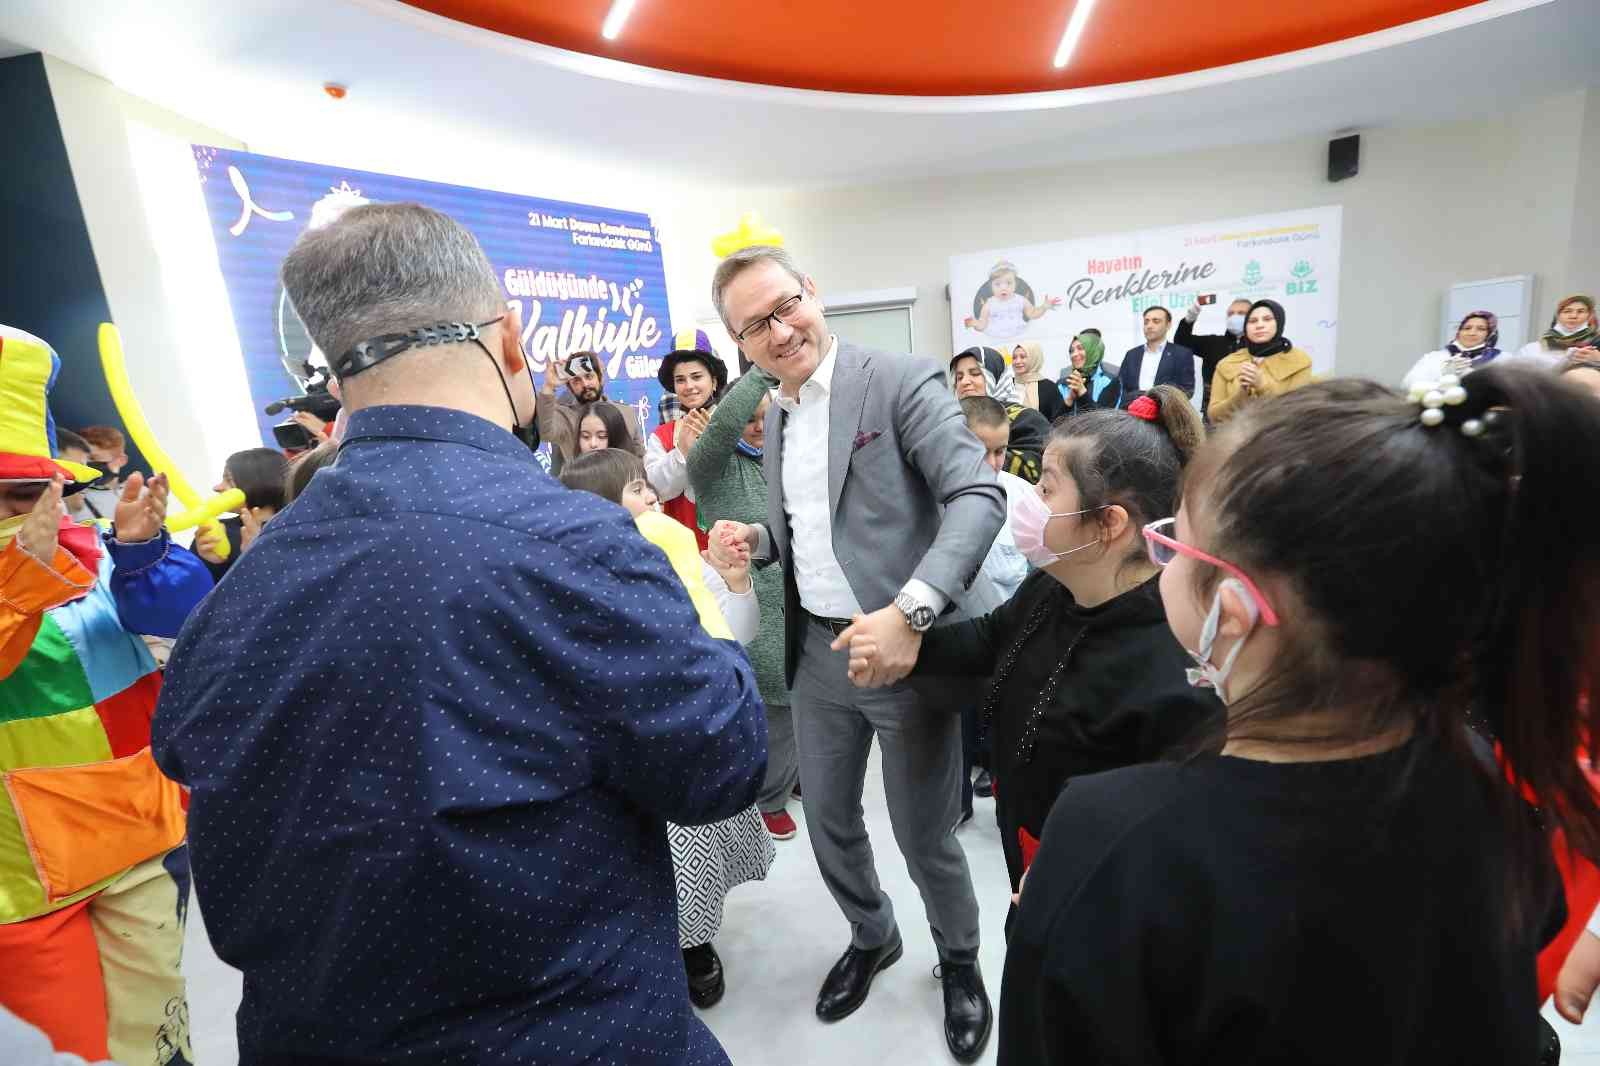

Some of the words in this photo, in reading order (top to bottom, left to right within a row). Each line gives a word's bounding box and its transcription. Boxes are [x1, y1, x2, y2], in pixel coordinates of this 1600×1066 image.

[542, 214, 568, 230] Mart
[1087, 255, 1143, 275] Hayatın
[504, 268, 609, 300] Güldüğünde
[1066, 261, 1217, 310] Renklerine
[505, 299, 662, 380] Kalbiyle
